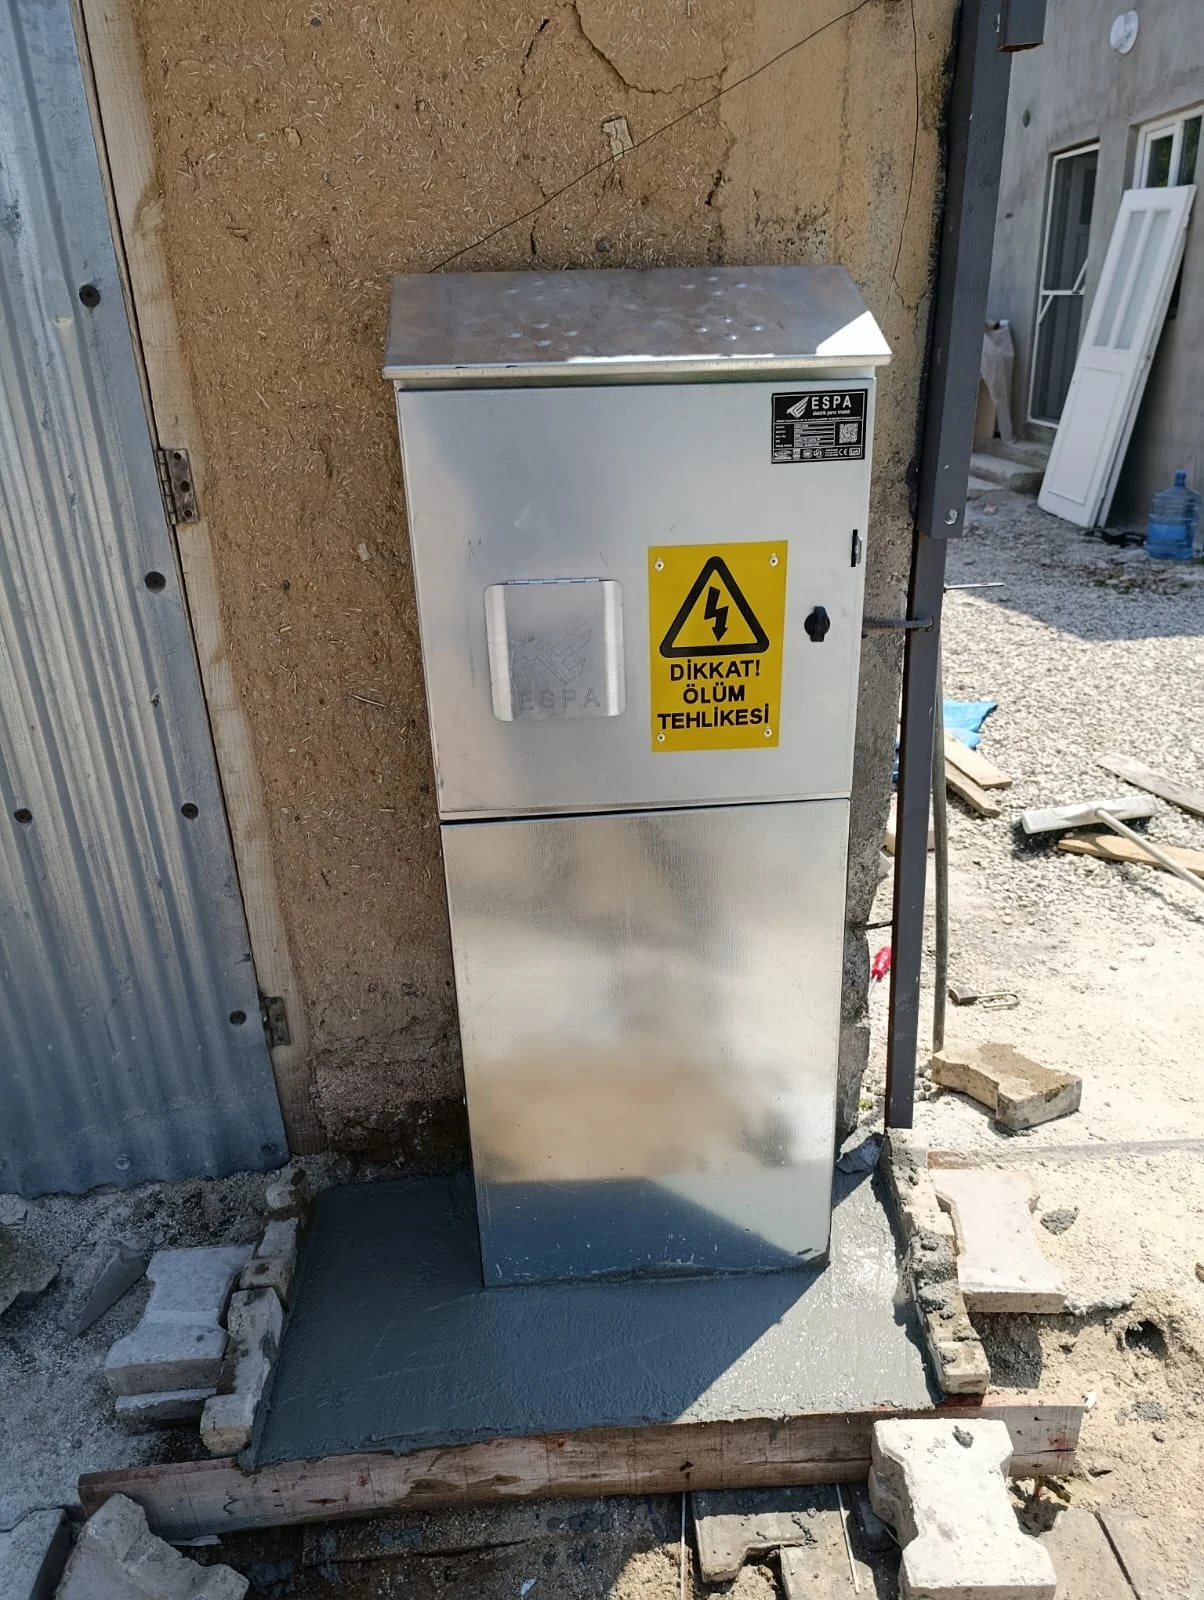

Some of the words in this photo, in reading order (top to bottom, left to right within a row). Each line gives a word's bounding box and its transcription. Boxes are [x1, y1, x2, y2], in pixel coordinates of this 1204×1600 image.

[811, 395, 852, 409] ESPA
[670, 659, 760, 681] DİKKAT!
[519, 688, 601, 711] ESPA
[683, 682, 745, 704] ÖLÜM
[657, 704, 769, 730] TEHLİKESİ
